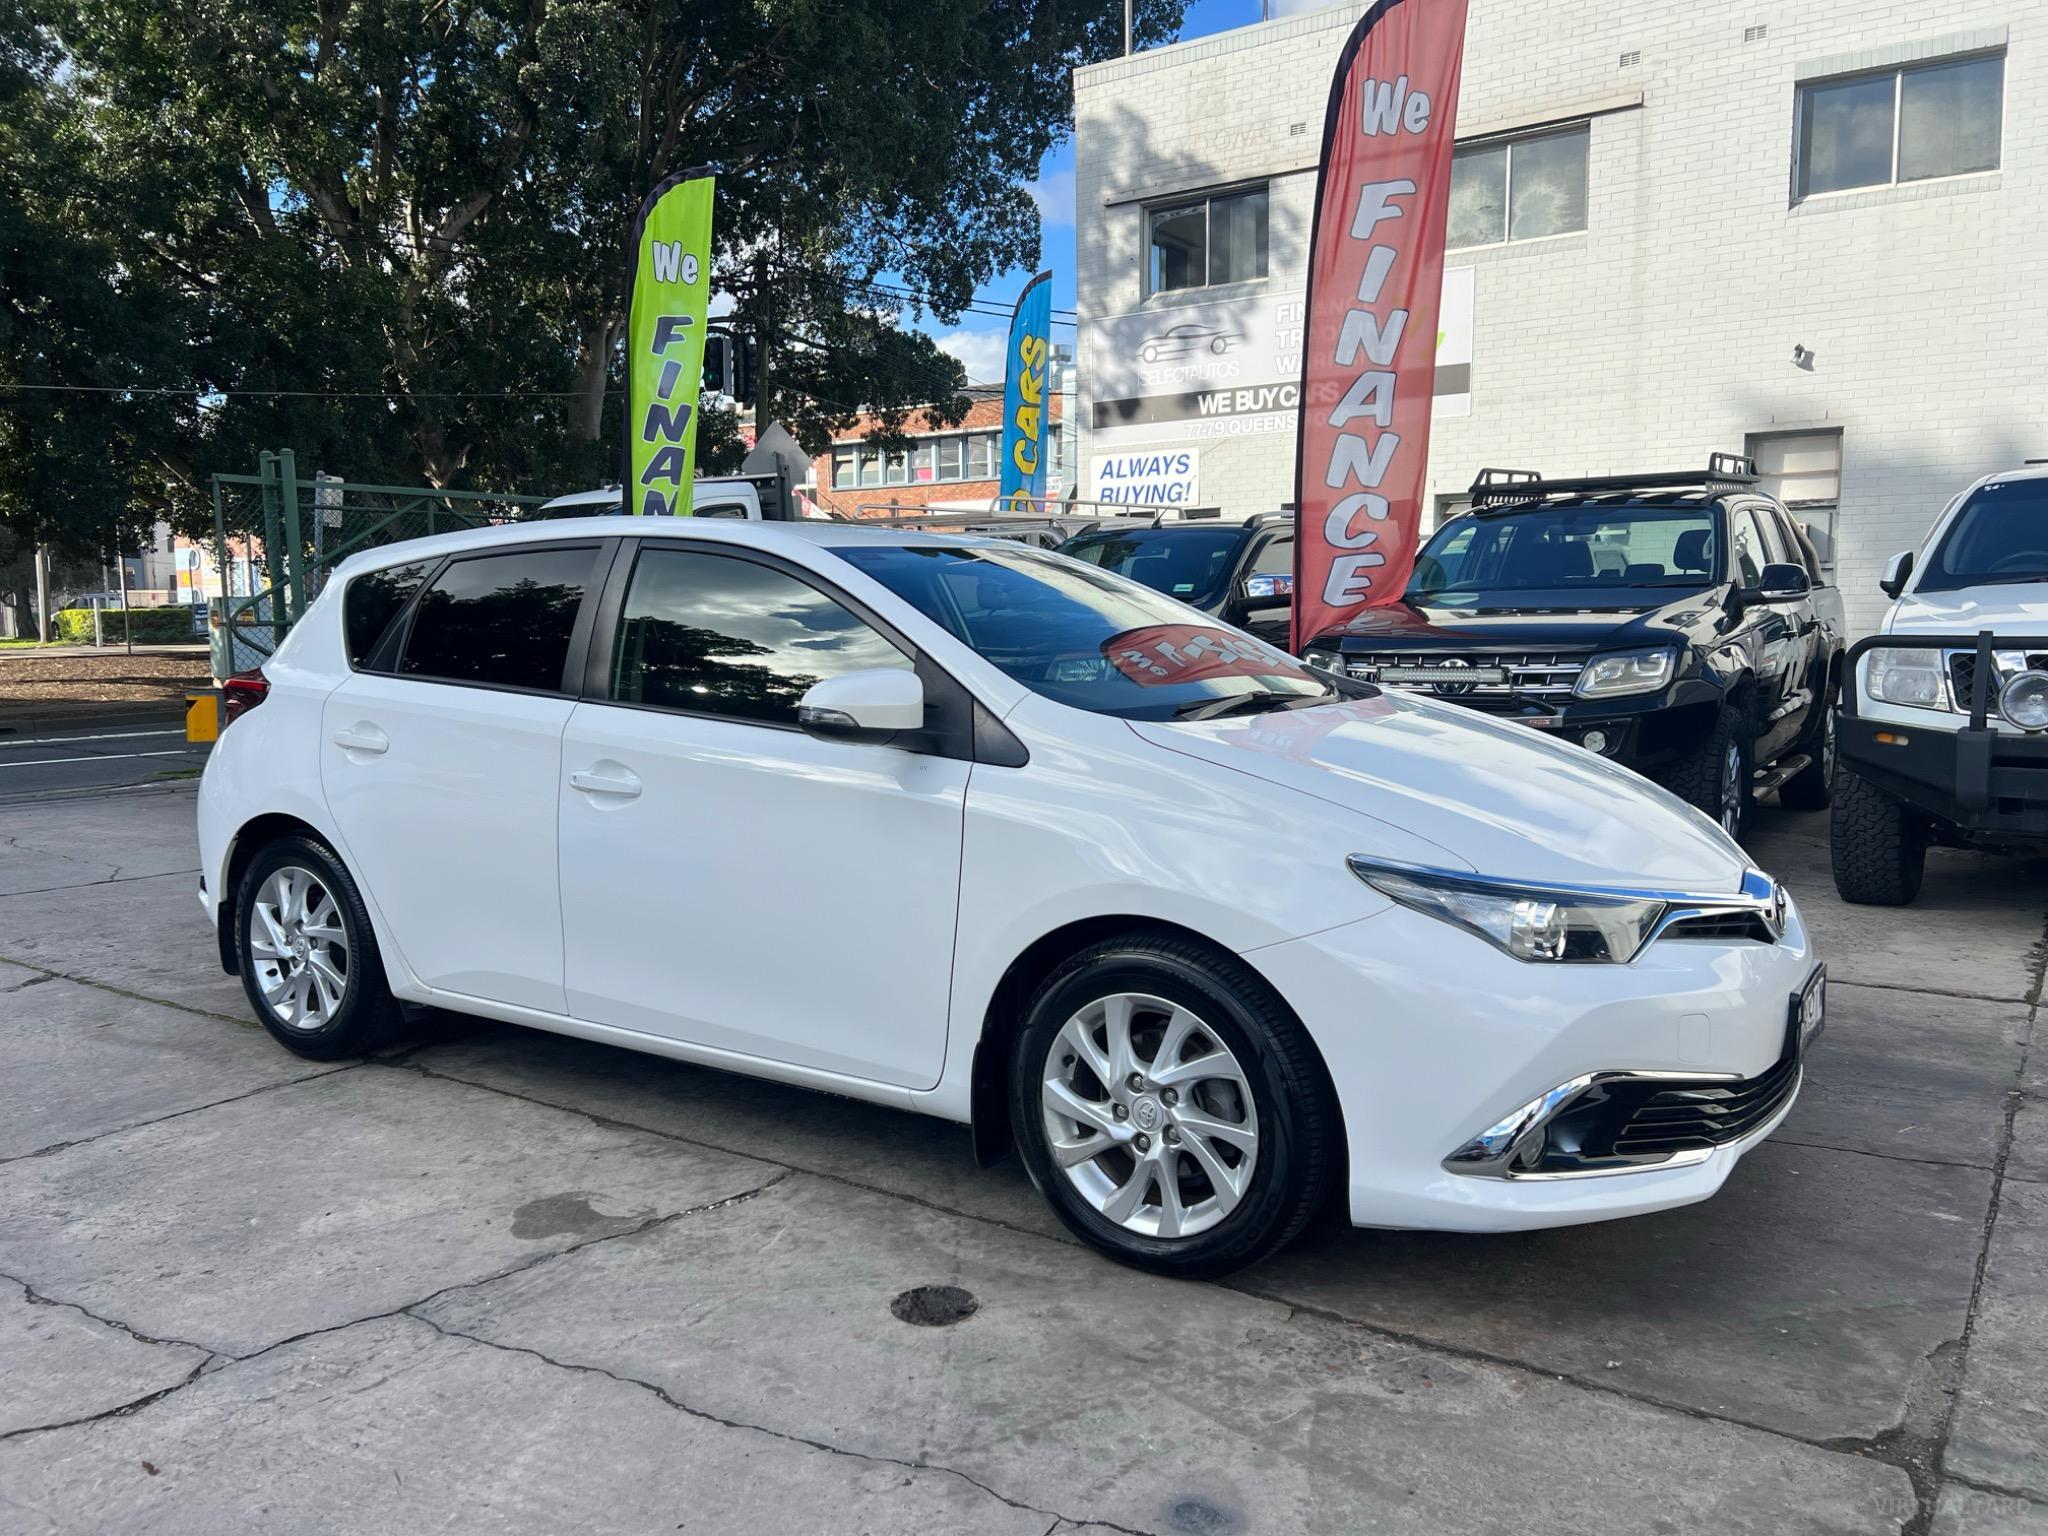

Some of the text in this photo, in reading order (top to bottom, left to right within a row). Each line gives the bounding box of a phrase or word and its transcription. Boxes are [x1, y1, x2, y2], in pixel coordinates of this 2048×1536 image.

[1361, 74, 1432, 138] We
[652, 240, 699, 286] We
[1013, 333, 1048, 476] CARS
[1197, 391, 1232, 416] WE
[1235, 386, 1279, 412] BUY
[1321, 178, 1417, 608] FINANCE
[1185, 421, 1225, 439] 77-79
[1099, 453, 1191, 480] ALWAYS
[1099, 481, 1192, 505] BUYING!
